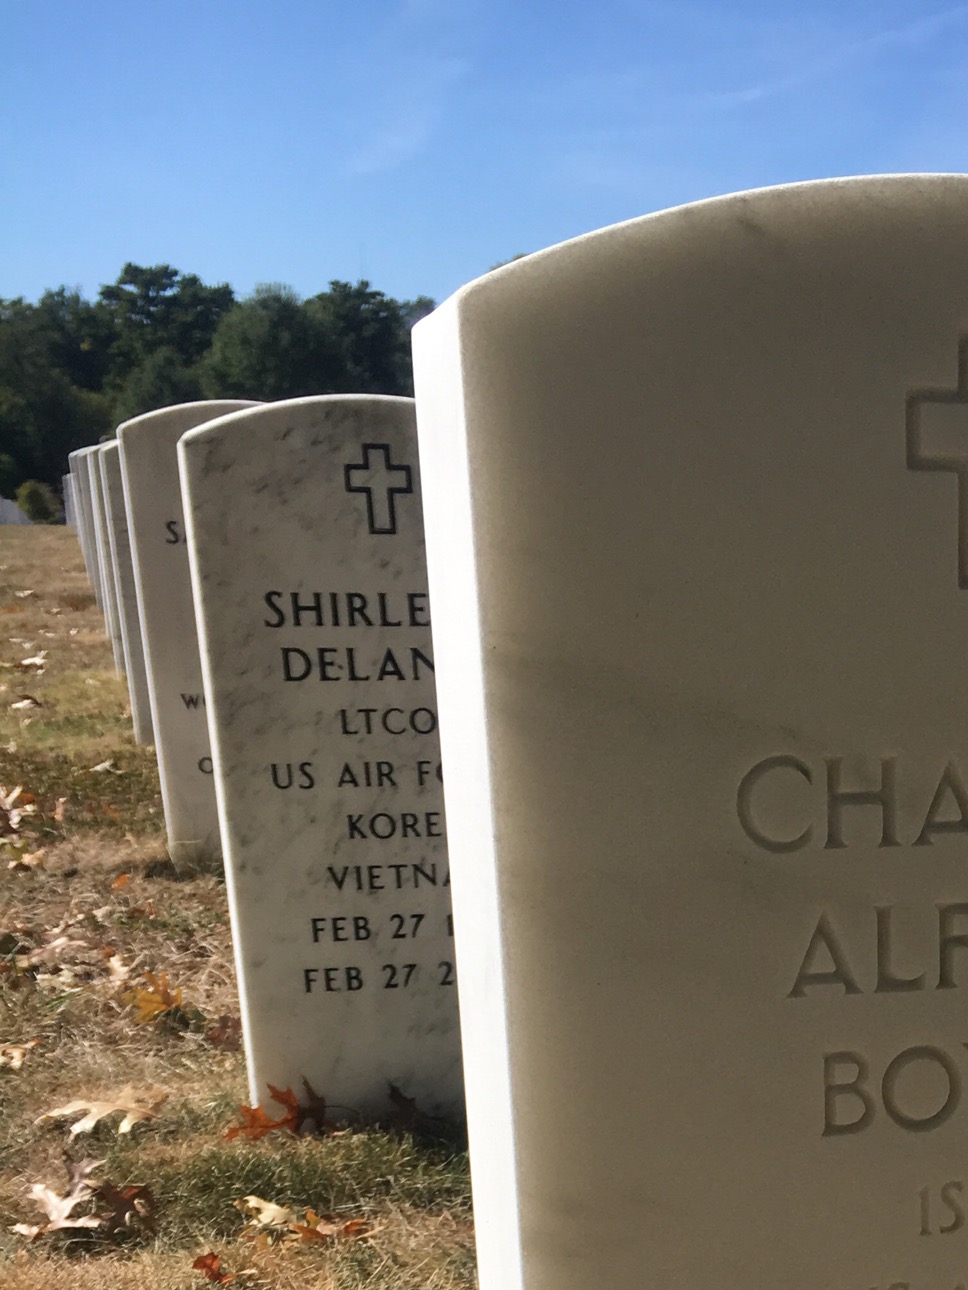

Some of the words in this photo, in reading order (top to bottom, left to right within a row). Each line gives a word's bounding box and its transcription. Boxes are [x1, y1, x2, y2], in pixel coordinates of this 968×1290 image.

[264, 591, 431, 627] SHIRLE
[281, 647, 435, 681] DELAN
[339, 707, 437, 735] LTCO
[271, 762, 315, 789] US
[338, 761, 398, 788] AIR
[346, 812, 443, 839] KORE
[327, 864, 450, 891] VIETN
[311, 916, 371, 943] FEB
[390, 914, 426, 939] 27
[304, 966, 364, 993] FEB
[382, 964, 418, 989] 27
